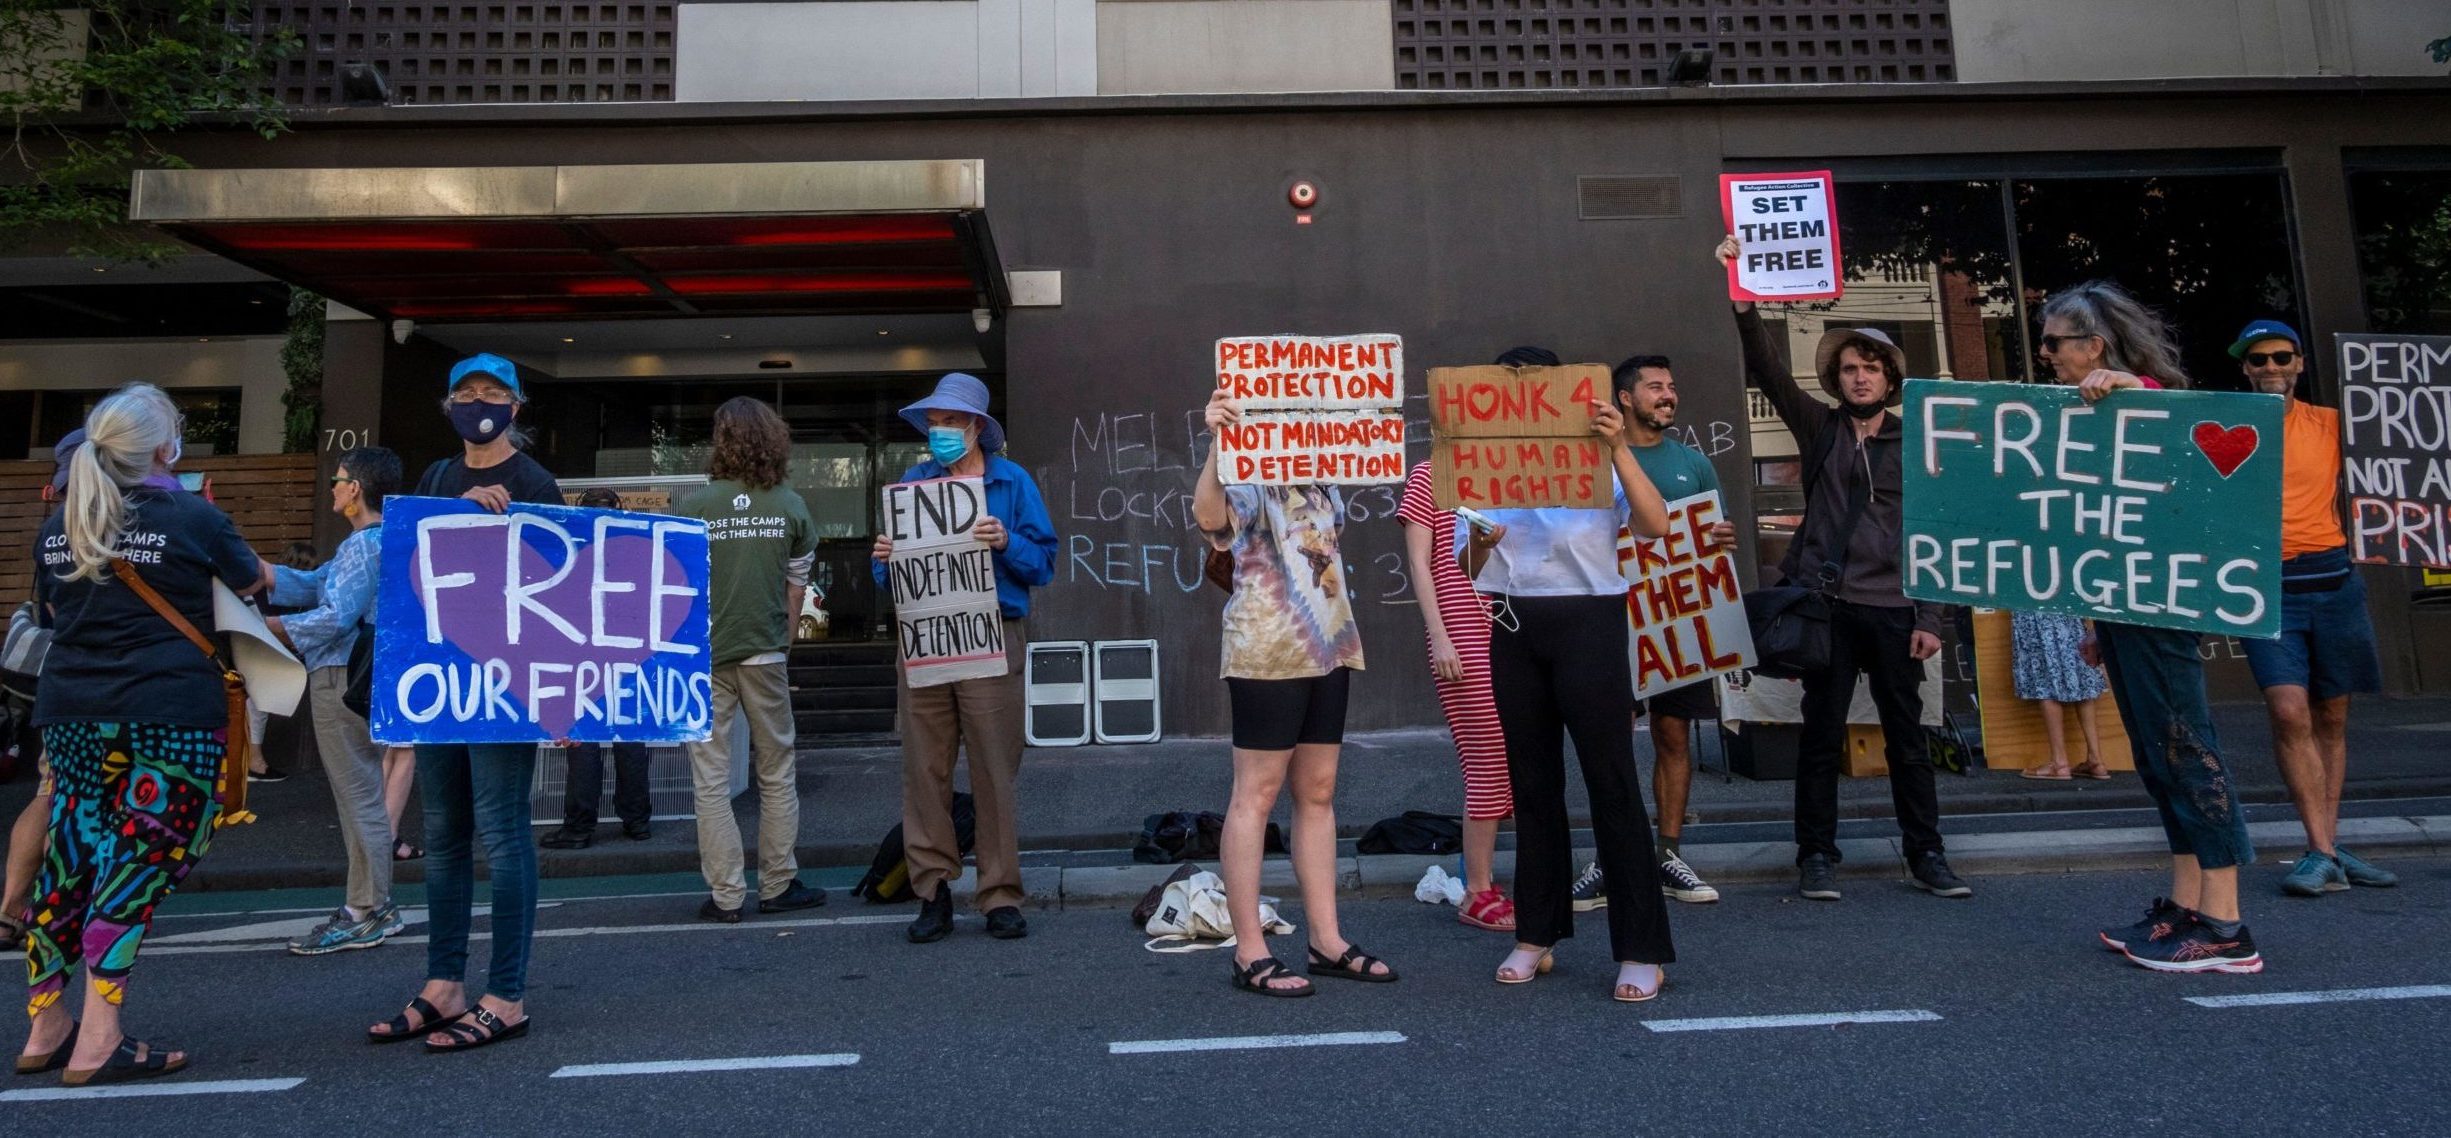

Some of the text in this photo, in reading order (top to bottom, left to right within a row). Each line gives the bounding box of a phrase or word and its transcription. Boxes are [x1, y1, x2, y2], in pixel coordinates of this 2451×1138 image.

[1752, 195, 1808, 214] SET
[1738, 219, 1825, 243] THEM
[1747, 248, 1824, 273] FREE
[1219, 340, 1398, 371] PERMANENT
[1218, 372, 1394, 400] PROTECTION
[1438, 381, 1561, 425] HONK
[1569, 376, 1598, 417] 4
[325, 428, 369, 452] 701
[1220, 422, 1278, 452] NOT
[1282, 418, 1404, 449] MANDATORY
[1922, 395, 2173, 493] FREE
[1236, 452, 1402, 482] DETENTION
[1453, 441, 1600, 470] HUMAN
[1457, 473, 1594, 505] RIGHTS
[2346, 456, 2412, 499] NOT
[708, 516, 786, 530] OSE THE CAMPS
[889, 481, 979, 541] END
[2018, 489, 2149, 545] THE
[117, 532, 167, 547] AMPS
[708, 528, 785, 541] ING THEM HERE
[2354, 498, 2451, 566] PRI
[44, 549, 162, 565] BRIN HERE
[417, 512, 705, 655] FREE
[891, 548, 994, 605] INDEFINITE
[1628, 555, 1740, 630] THEM
[1908, 534, 2266, 626] REFUGEES
[899, 609, 1003, 660] DETENTION
[1637, 616, 1743, 692] ALL
[397, 658, 712, 731] OUR FRIENDS
